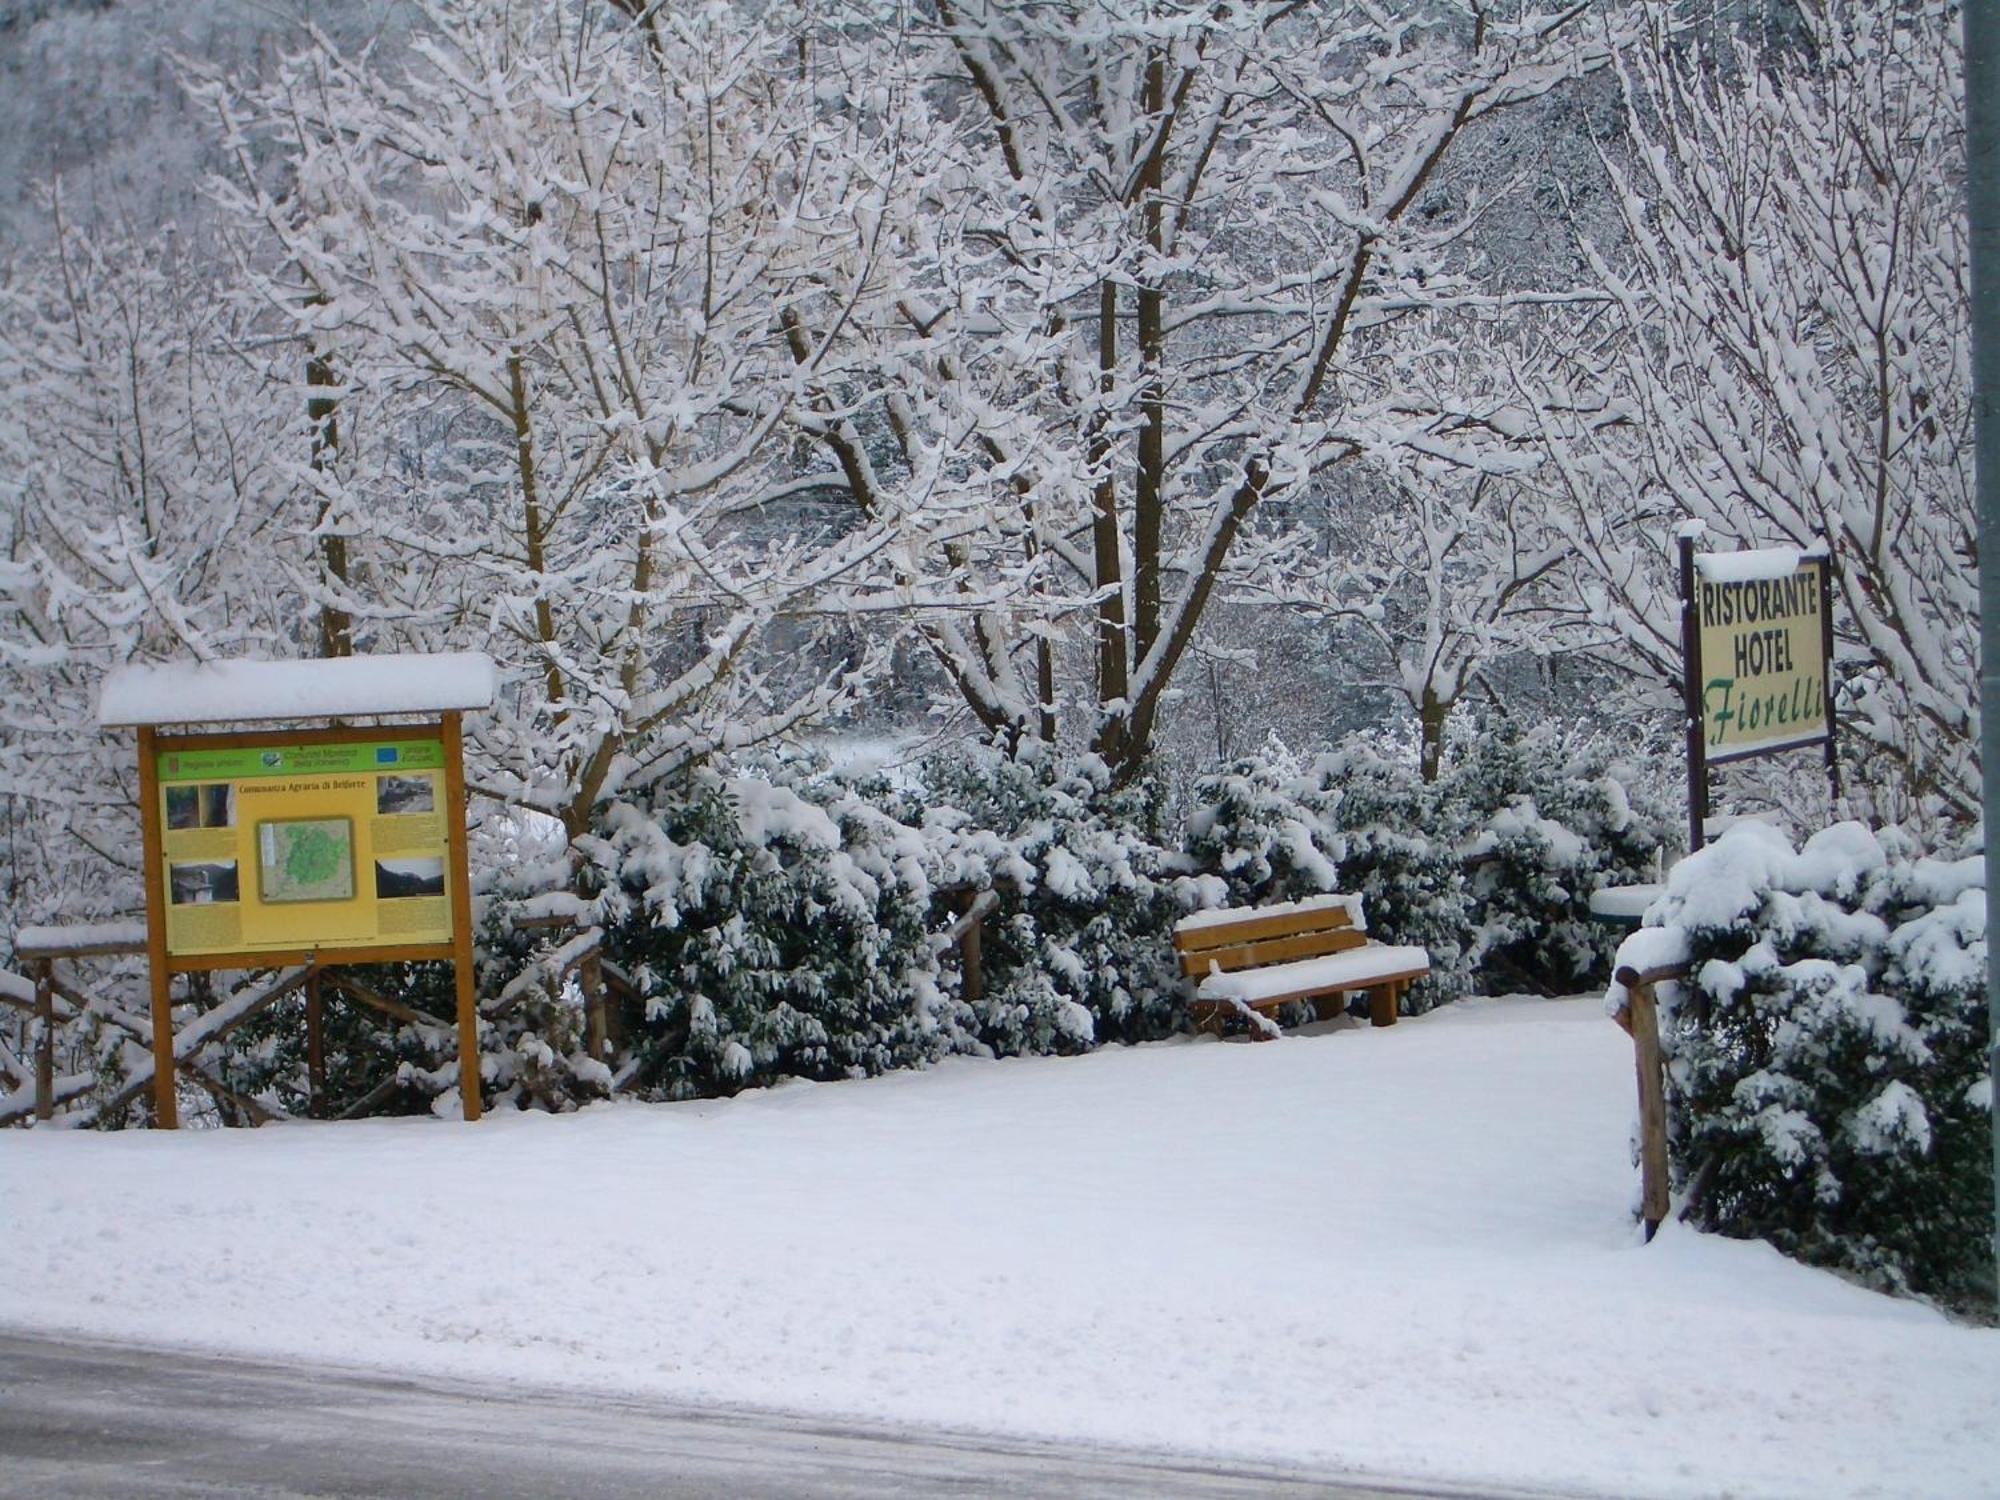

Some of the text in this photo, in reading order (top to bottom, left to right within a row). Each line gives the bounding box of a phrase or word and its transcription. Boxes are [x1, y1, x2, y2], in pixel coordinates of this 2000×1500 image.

[1703, 573, 1817, 627] RISTORANTE
[1734, 629, 1793, 678] HOTEL
[1703, 676, 1823, 745] Fiorelli
[288, 783, 319, 793] Agraria
[322, 782, 330, 790] di
